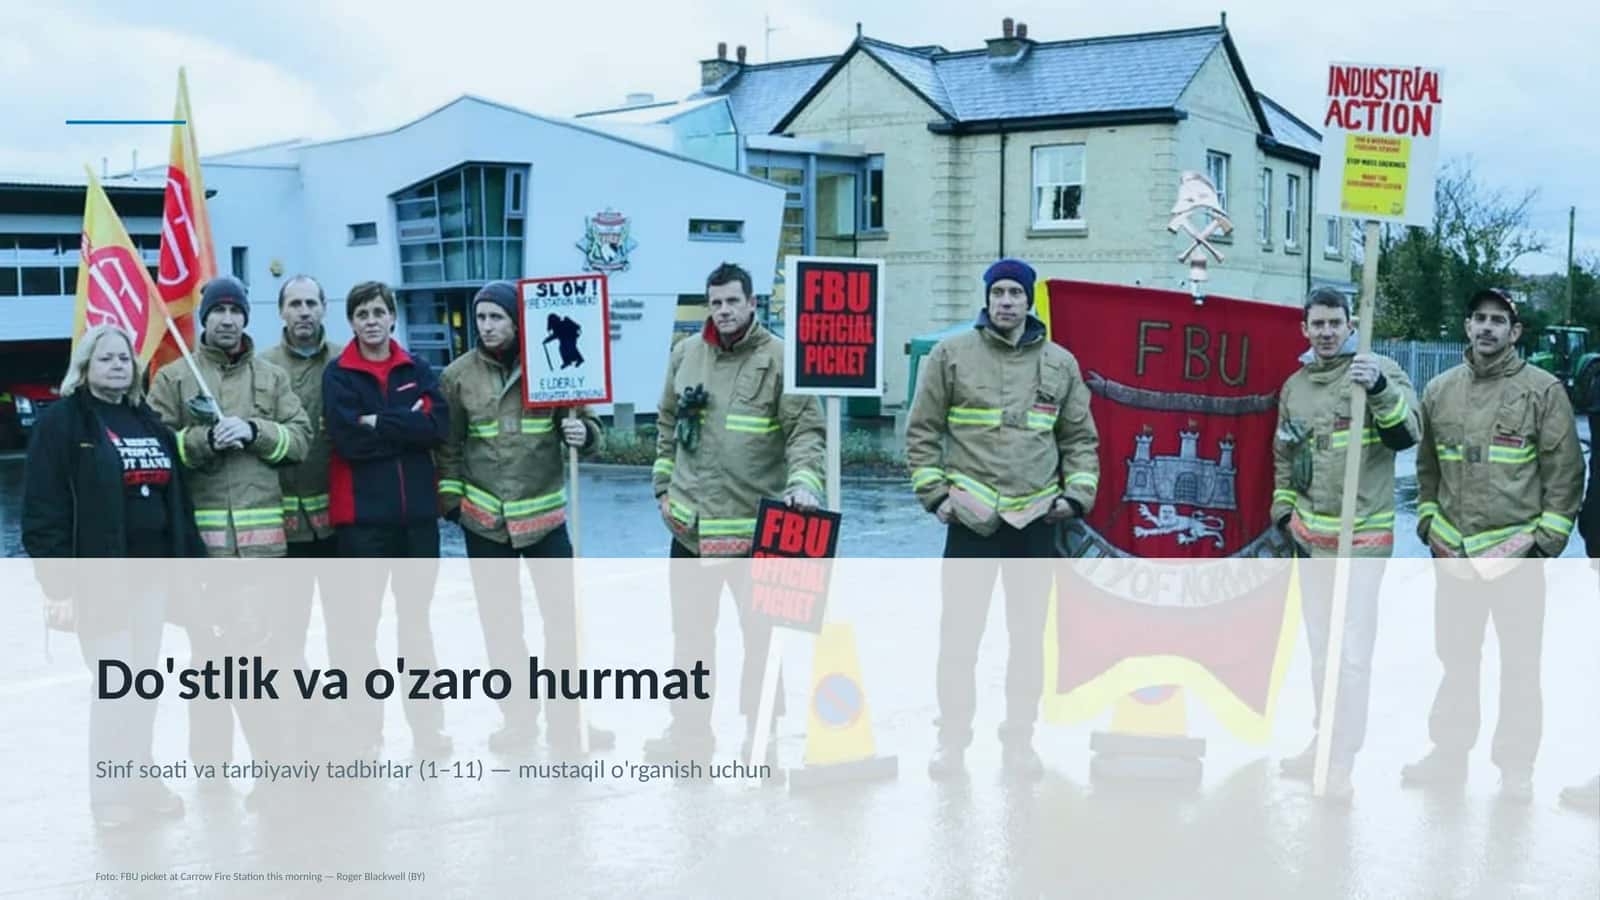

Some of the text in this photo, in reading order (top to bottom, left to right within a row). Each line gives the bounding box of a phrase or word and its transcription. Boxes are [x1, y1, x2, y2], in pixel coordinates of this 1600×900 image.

[1328, 65, 1442, 104] INDUSTRIAL
[1324, 99, 1433, 136] ACTION
[804, 269, 871, 313] FBU
[799, 313, 875, 344] OFFICIAL
[804, 345, 867, 376] PICKET
[1134, 321, 1249, 386] FBU
[539, 376, 585, 391] ELDERLY
[761, 507, 832, 558] FBU
[752, 551, 825, 593] OFFICIAL
[752, 584, 816, 624] PICKET
